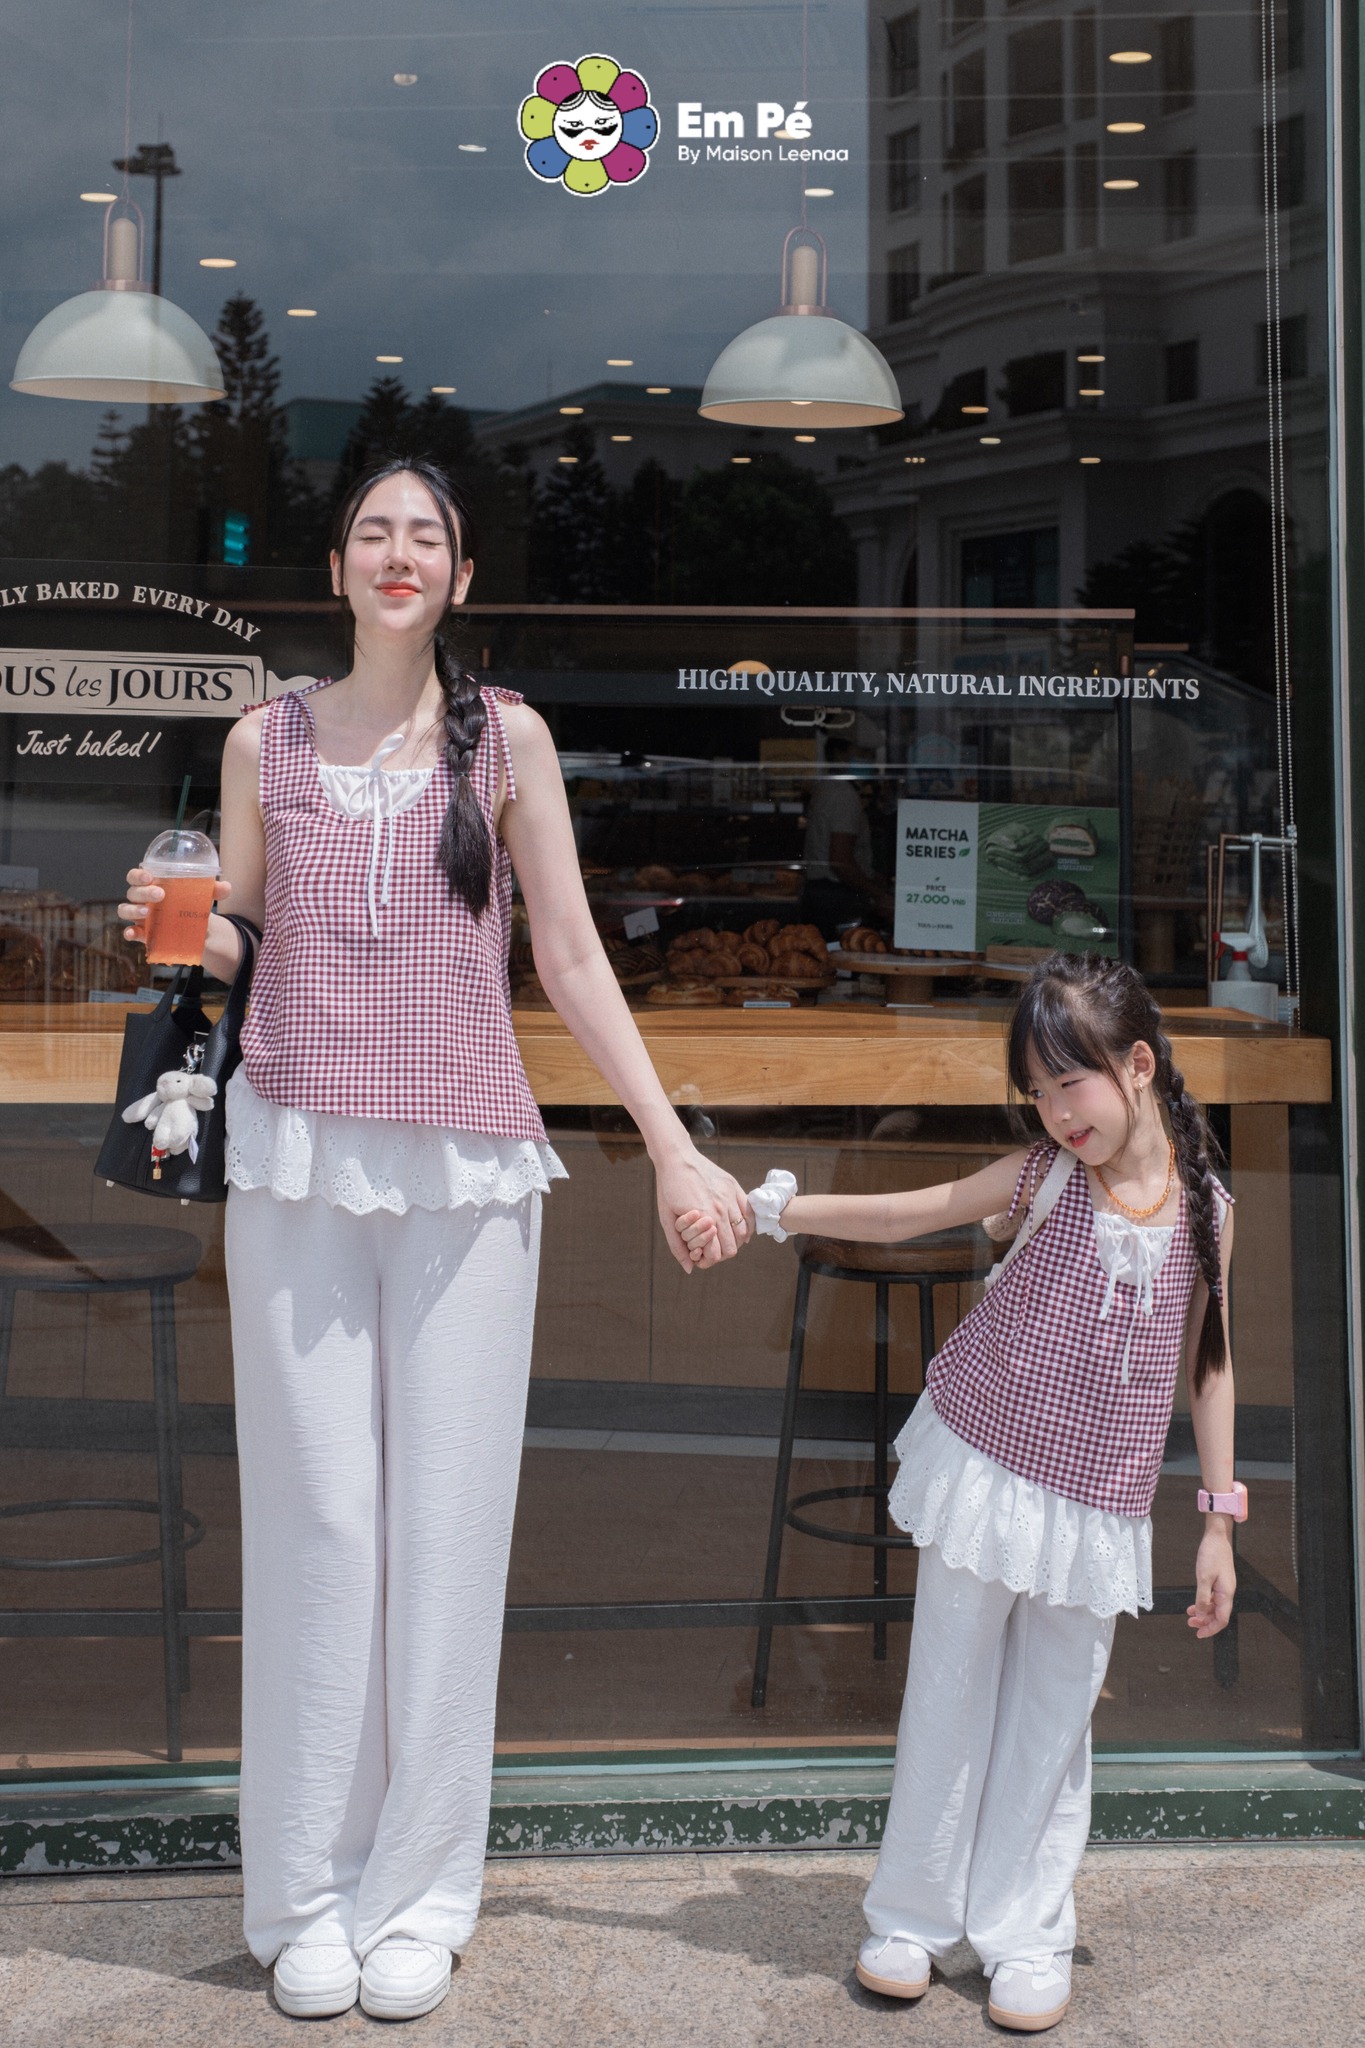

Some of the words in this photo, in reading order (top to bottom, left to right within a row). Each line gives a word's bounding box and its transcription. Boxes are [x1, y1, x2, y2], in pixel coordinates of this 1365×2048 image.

[0, 585, 28, 607] LY
[36, 582, 119, 601] BAKED
[132, 585, 210, 619] EVERY
[212, 607, 261, 642] DAY
[0, 665, 56, 697] US
[65, 665, 102, 697] les
[106, 668, 233, 707] JOURS
[677, 668, 749, 691] HIGH
[756, 670, 880, 697] QUALITY,
[886, 672, 1012, 696] NATURAL
[1017, 675, 1200, 700] INGREDIENTS
[17, 730, 71, 755] Just
[76, 730, 162, 757] baked!
[906, 827, 968, 842] MATCHA
[905, 844, 956, 859] SERIES
[926, 884, 946, 892] PRICE
[906, 893, 950, 905] 27.000
